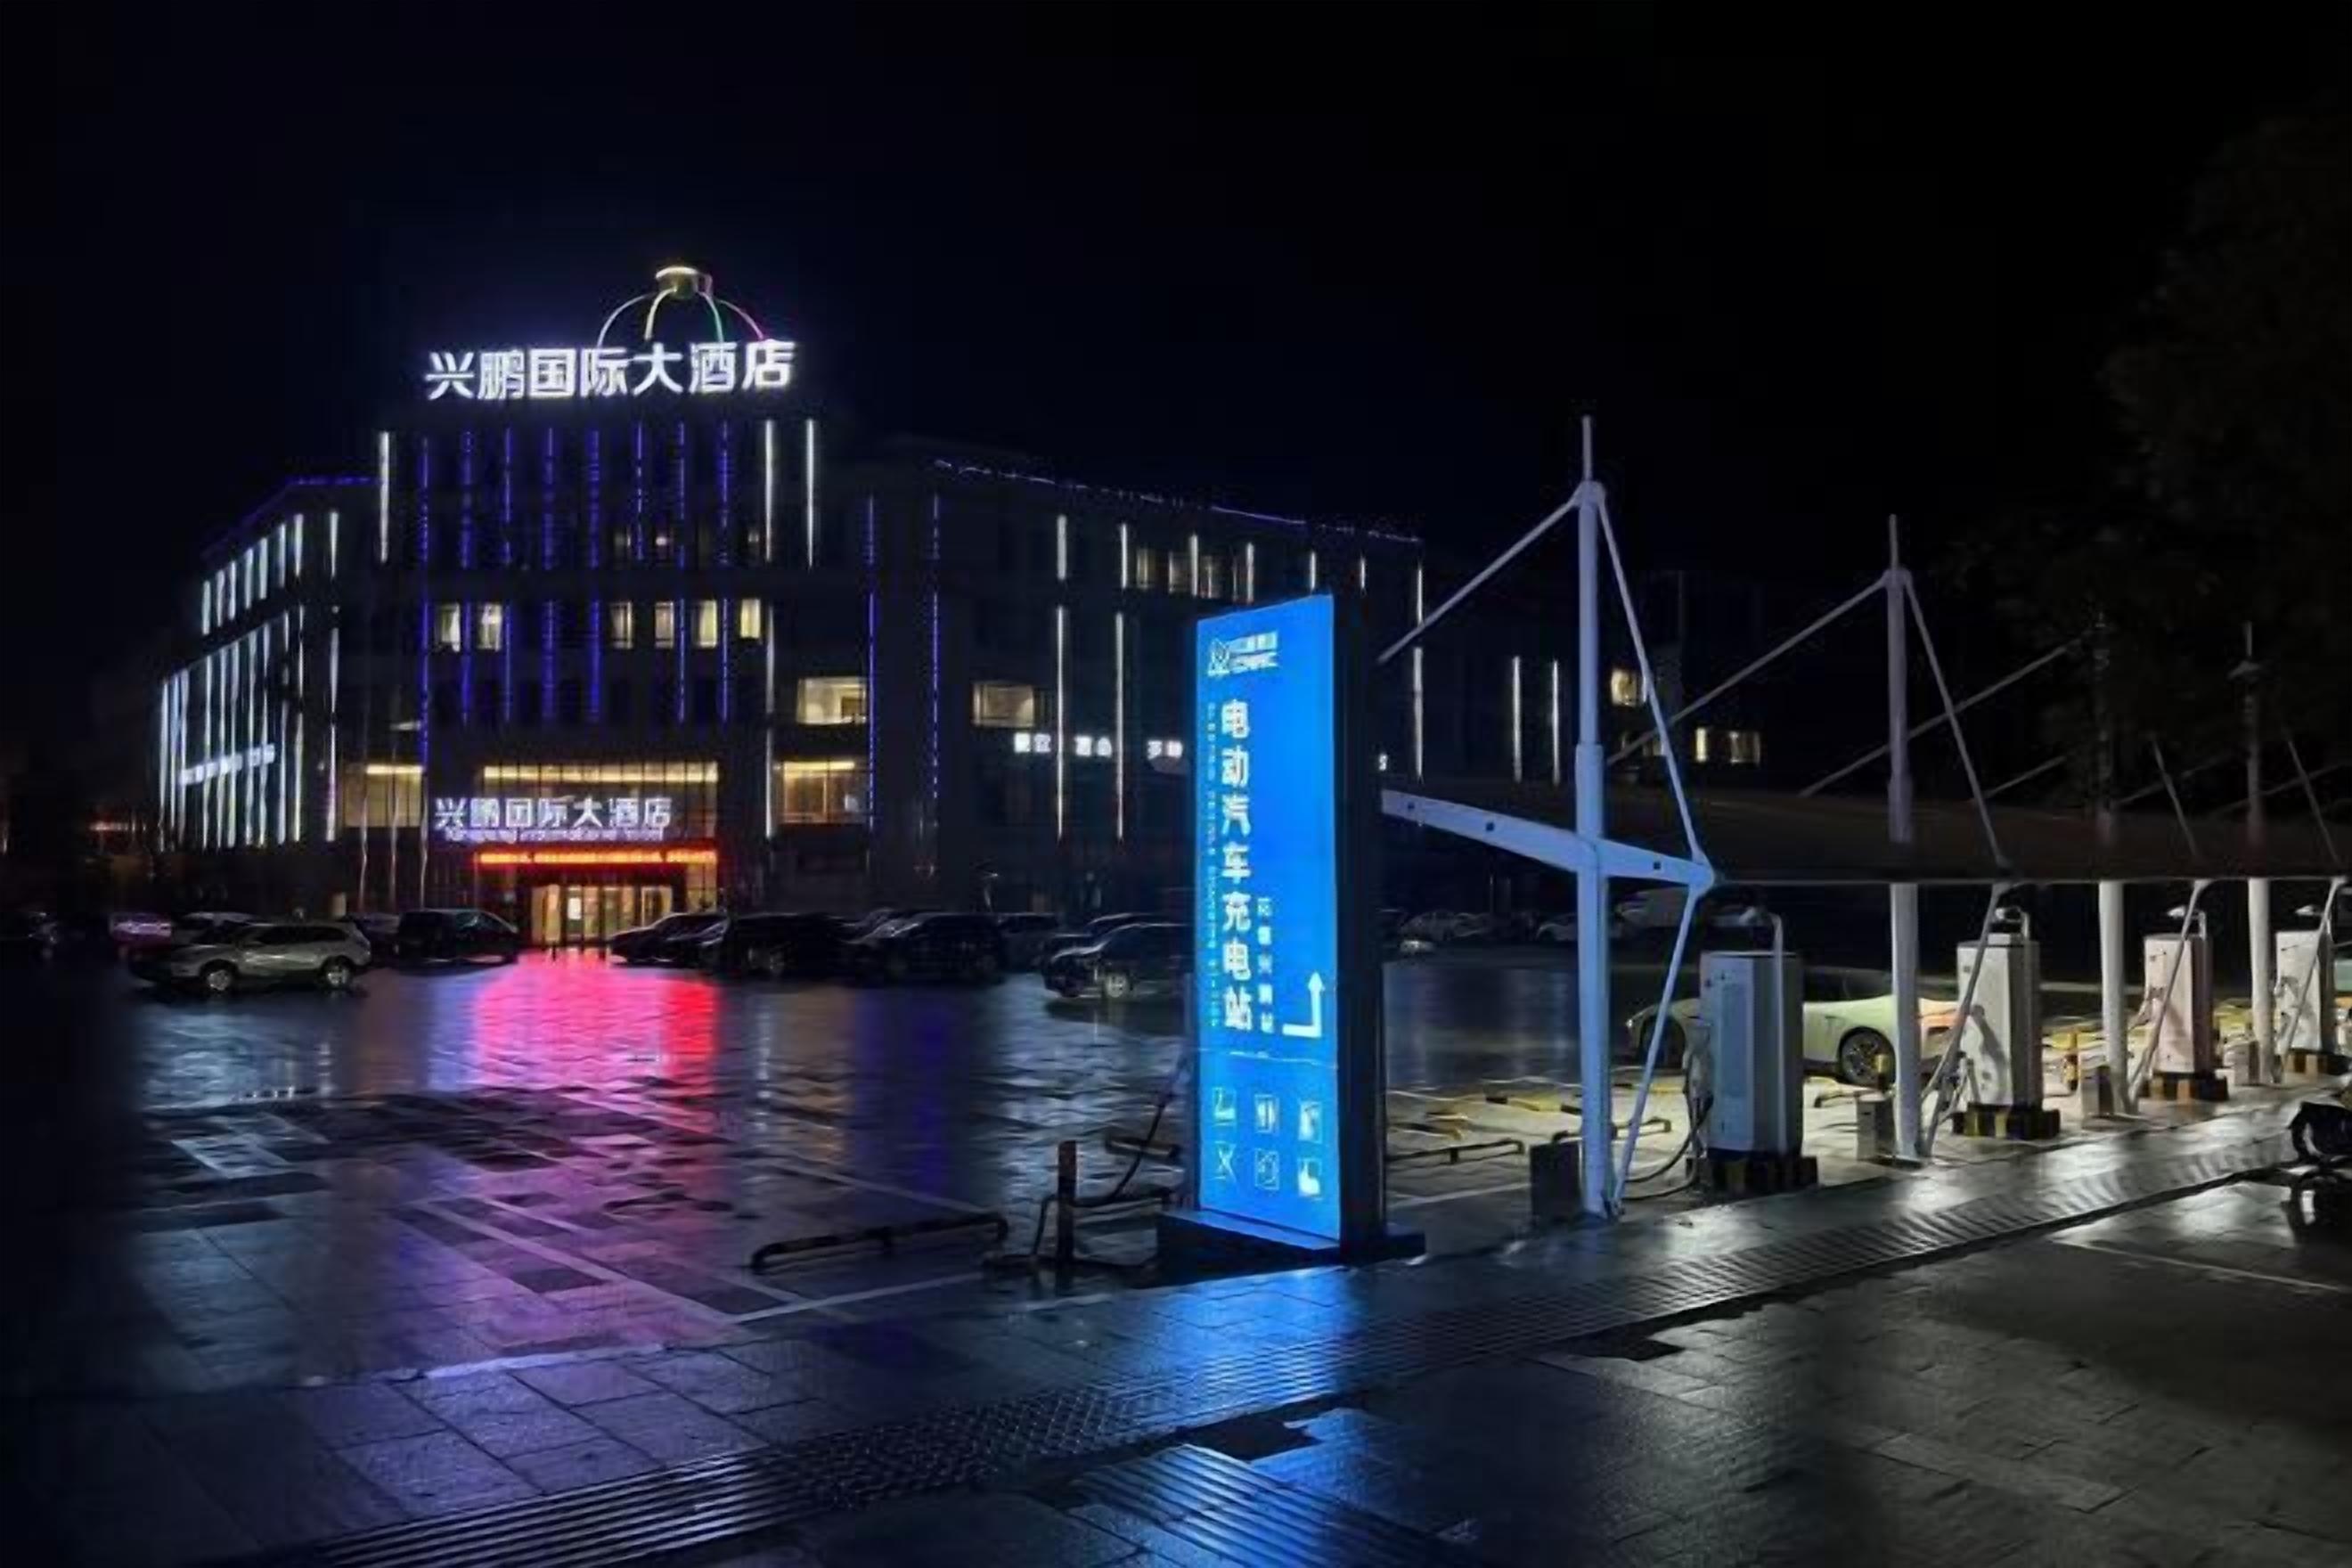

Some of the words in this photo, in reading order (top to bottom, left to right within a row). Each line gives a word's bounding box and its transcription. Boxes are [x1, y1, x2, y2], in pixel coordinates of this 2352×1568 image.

[425, 338, 796, 400] 兴鹏国际大酒店
[434, 796, 673, 829] 兴鹏国际大酒店
[1221, 699, 1252, 1031] 电动汽车充电站
